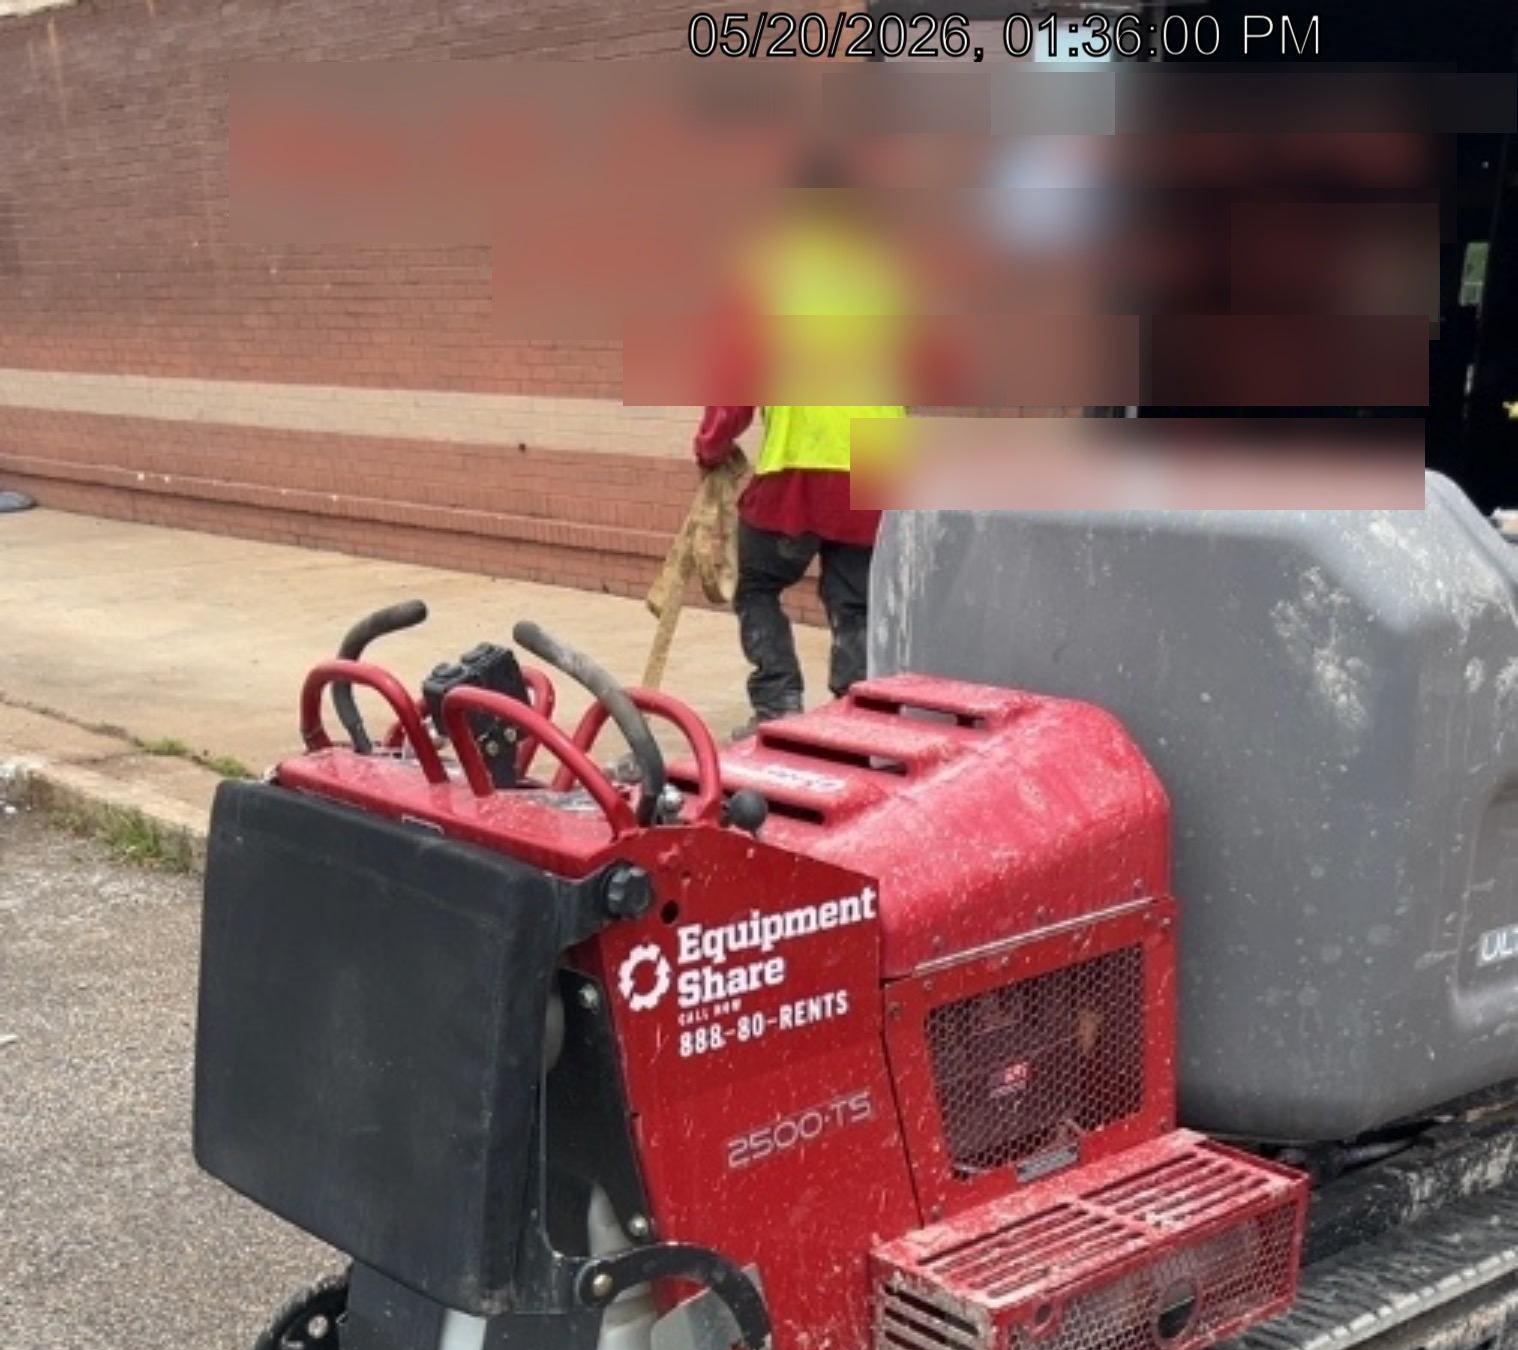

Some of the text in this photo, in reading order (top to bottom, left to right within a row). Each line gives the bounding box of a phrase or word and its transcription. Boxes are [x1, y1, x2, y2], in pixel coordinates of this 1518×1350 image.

[676, 886, 877, 963] Equipment
[676, 955, 786, 1008] Share
[678, 989, 849, 1058] 888-80-RENTS
